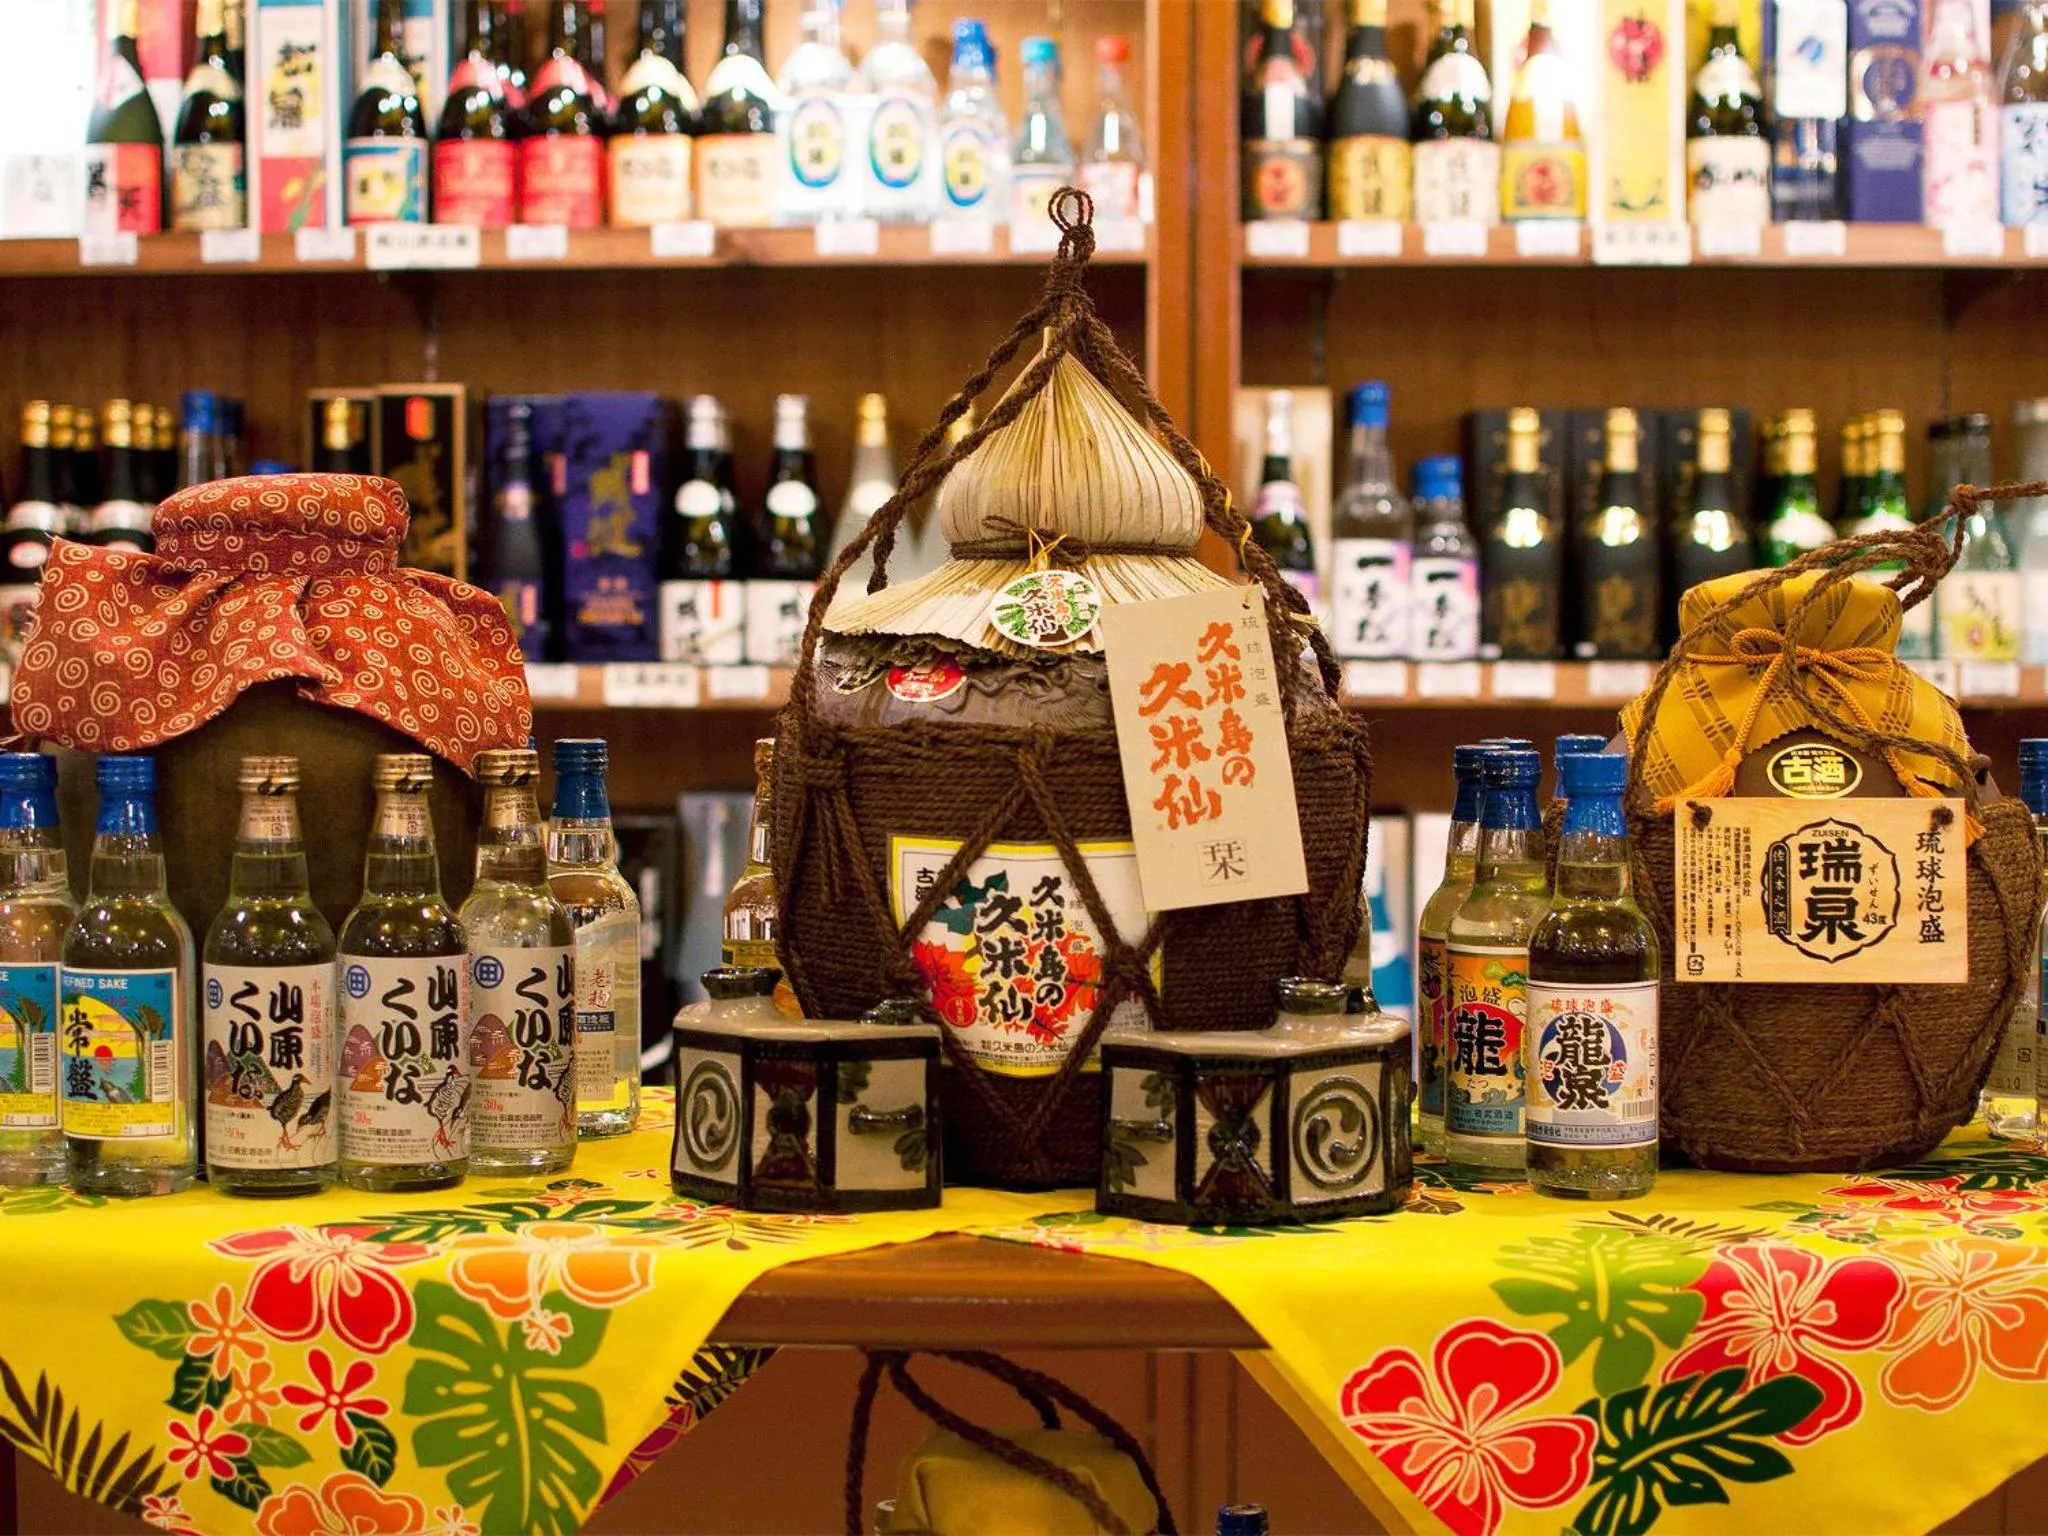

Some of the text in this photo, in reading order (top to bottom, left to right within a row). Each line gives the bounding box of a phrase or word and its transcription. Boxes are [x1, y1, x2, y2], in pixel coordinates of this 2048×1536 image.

[1021, 587, 1058, 635] 久米仙
[1138, 661, 1223, 831] 久米仙
[1197, 621, 1256, 788] 久米島の
[1780, 755, 1846, 785] 古酒
[1811, 829, 1851, 839] ZUISEN
[1796, 838, 1867, 945] 瑞泉
[1867, 861, 1881, 911] ずいせん
[1914, 830, 1946, 945] 琉球泡盛
[98, 977, 129, 990] SAKE
[976, 893, 1034, 1023] 久米仙
[1029, 875, 1066, 1008] 久米島の
[228, 980, 265, 1101] くいな
[268, 980, 304, 1071] 山原
[381, 977, 423, 1105] くいな
[426, 964, 460, 1061] 山原
[514, 967, 552, 1090] くいな
[1453, 1009, 1508, 1077] 龍
[1459, 984, 1503, 1006] 泡盛
[1550, 998, 1615, 1015] 琉球泡盛
[64, 1006, 98, 1101] 常盤
[1554, 1015, 1613, 1112] 龍泉
